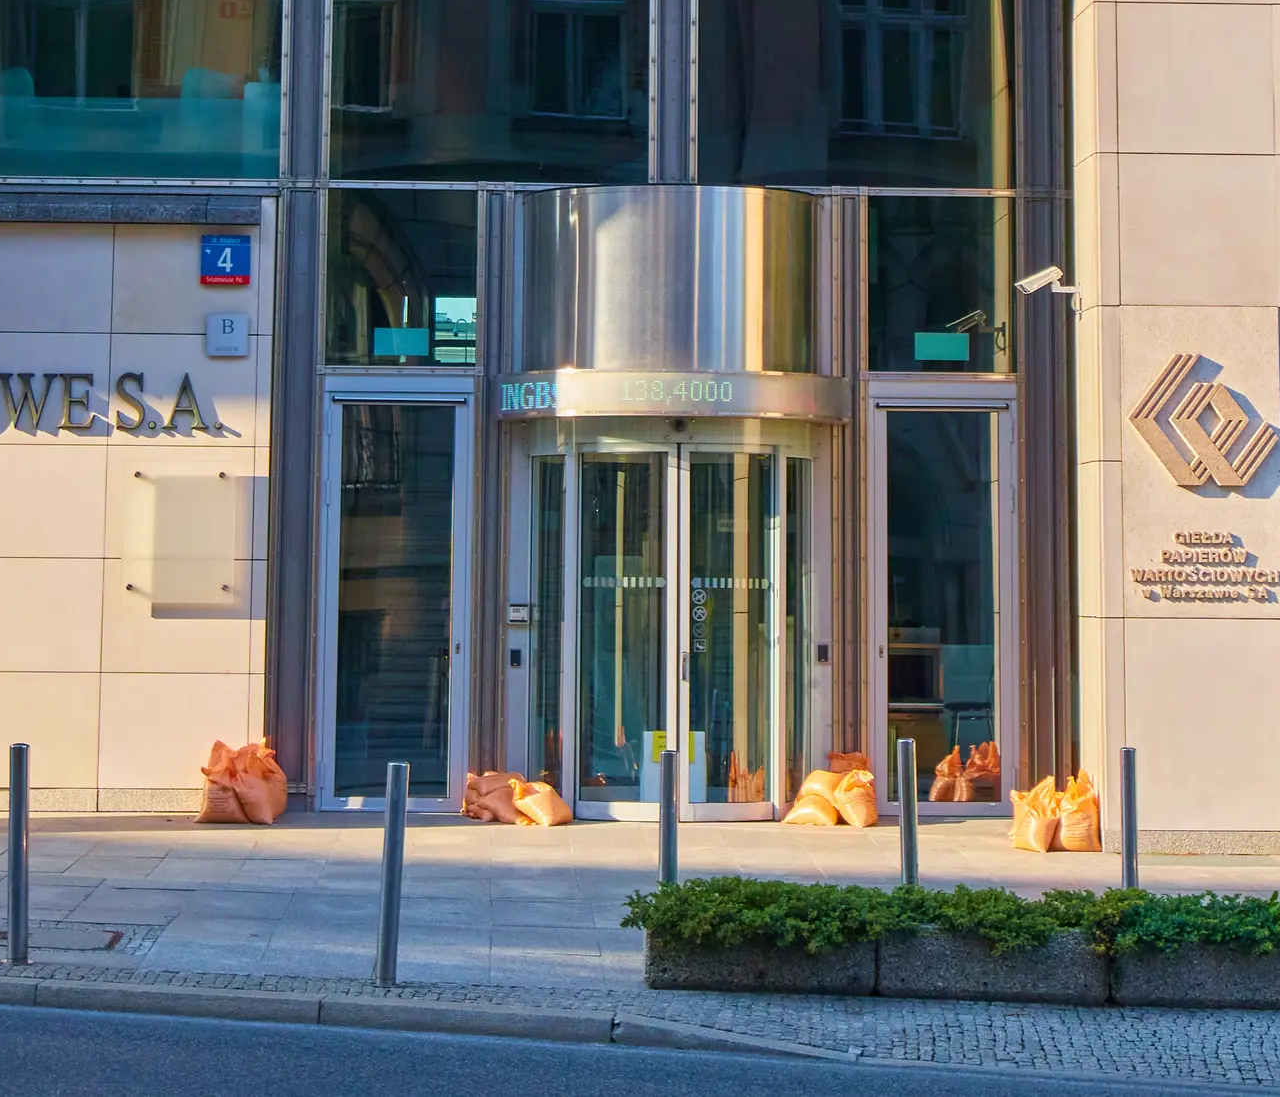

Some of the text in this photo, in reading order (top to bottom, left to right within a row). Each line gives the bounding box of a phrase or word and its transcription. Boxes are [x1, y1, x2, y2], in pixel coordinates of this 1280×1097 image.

[217, 247, 234, 273] 4
[221, 318, 235, 335] B
[116, 372, 223, 430] S.A.
[622, 380, 733, 406] 138,4000
[1174, 532, 1234, 545] GIEŁDA
[1160, 547, 1248, 564] PAPIERÓW
[1130, 567, 1280, 584] WARTOŚCIOWYCH
